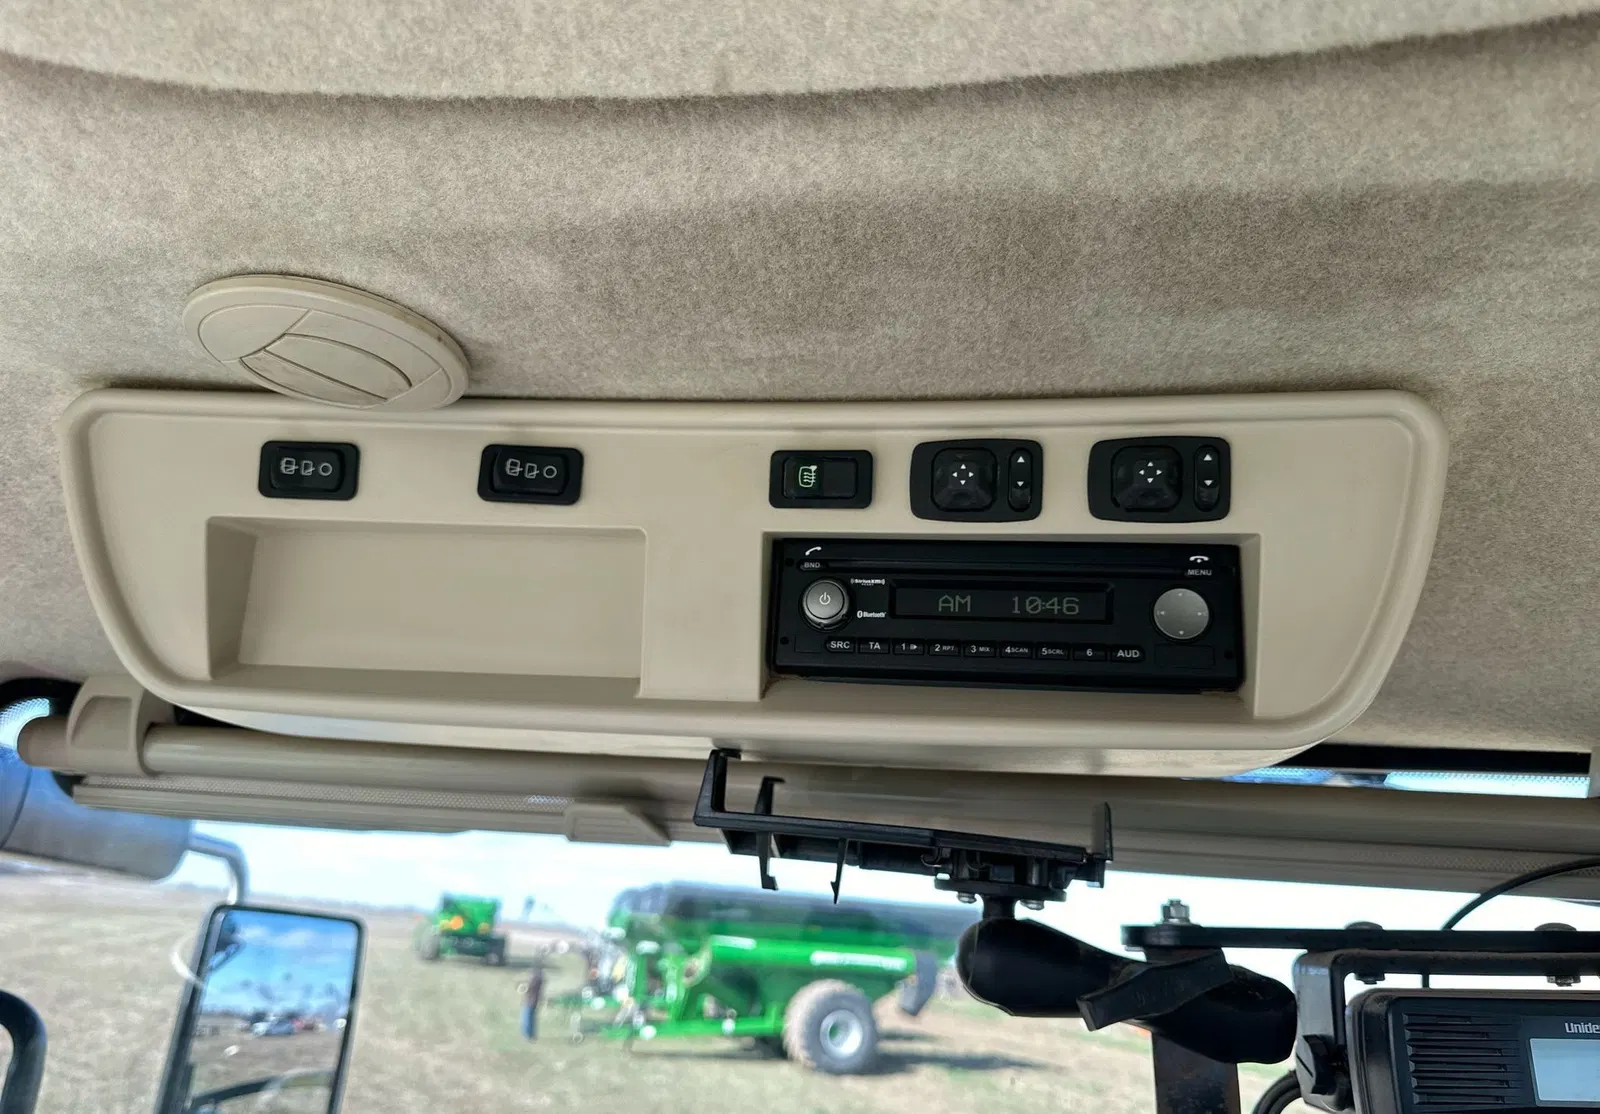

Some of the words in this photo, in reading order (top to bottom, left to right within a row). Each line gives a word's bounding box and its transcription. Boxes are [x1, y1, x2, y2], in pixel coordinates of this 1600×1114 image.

[804, 561, 821, 569] BND
[1187, 568, 1212, 577] MENU
[938, 595, 971, 613] AM
[1012, 596, 1080, 615] 10:46
[830, 640, 851, 650] SRC
[868, 641, 881, 650] TA
[901, 643, 906, 651] 1
[934, 644, 941, 652] 2
[970, 645, 977, 653] 3
[1086, 648, 1093, 657] 6
[1117, 649, 1140, 658] AUD
